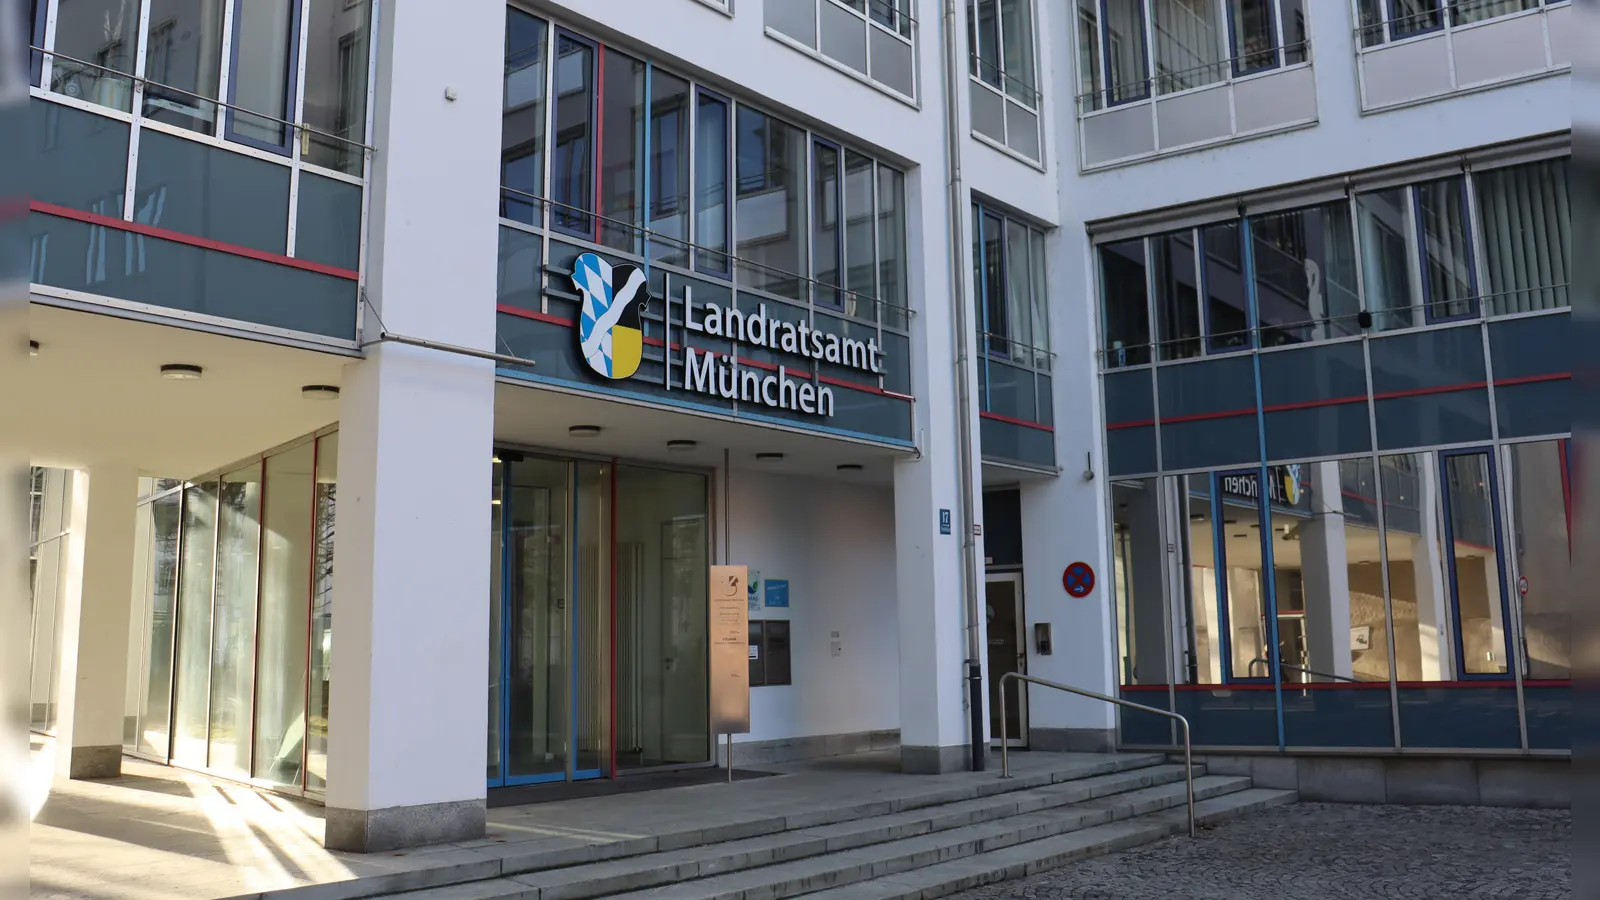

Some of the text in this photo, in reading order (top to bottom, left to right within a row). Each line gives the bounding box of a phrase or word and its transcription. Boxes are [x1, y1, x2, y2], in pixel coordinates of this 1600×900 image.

[684, 285, 880, 373] Landratsamt
[685, 347, 834, 417] München
[942, 511, 949, 524] 17
